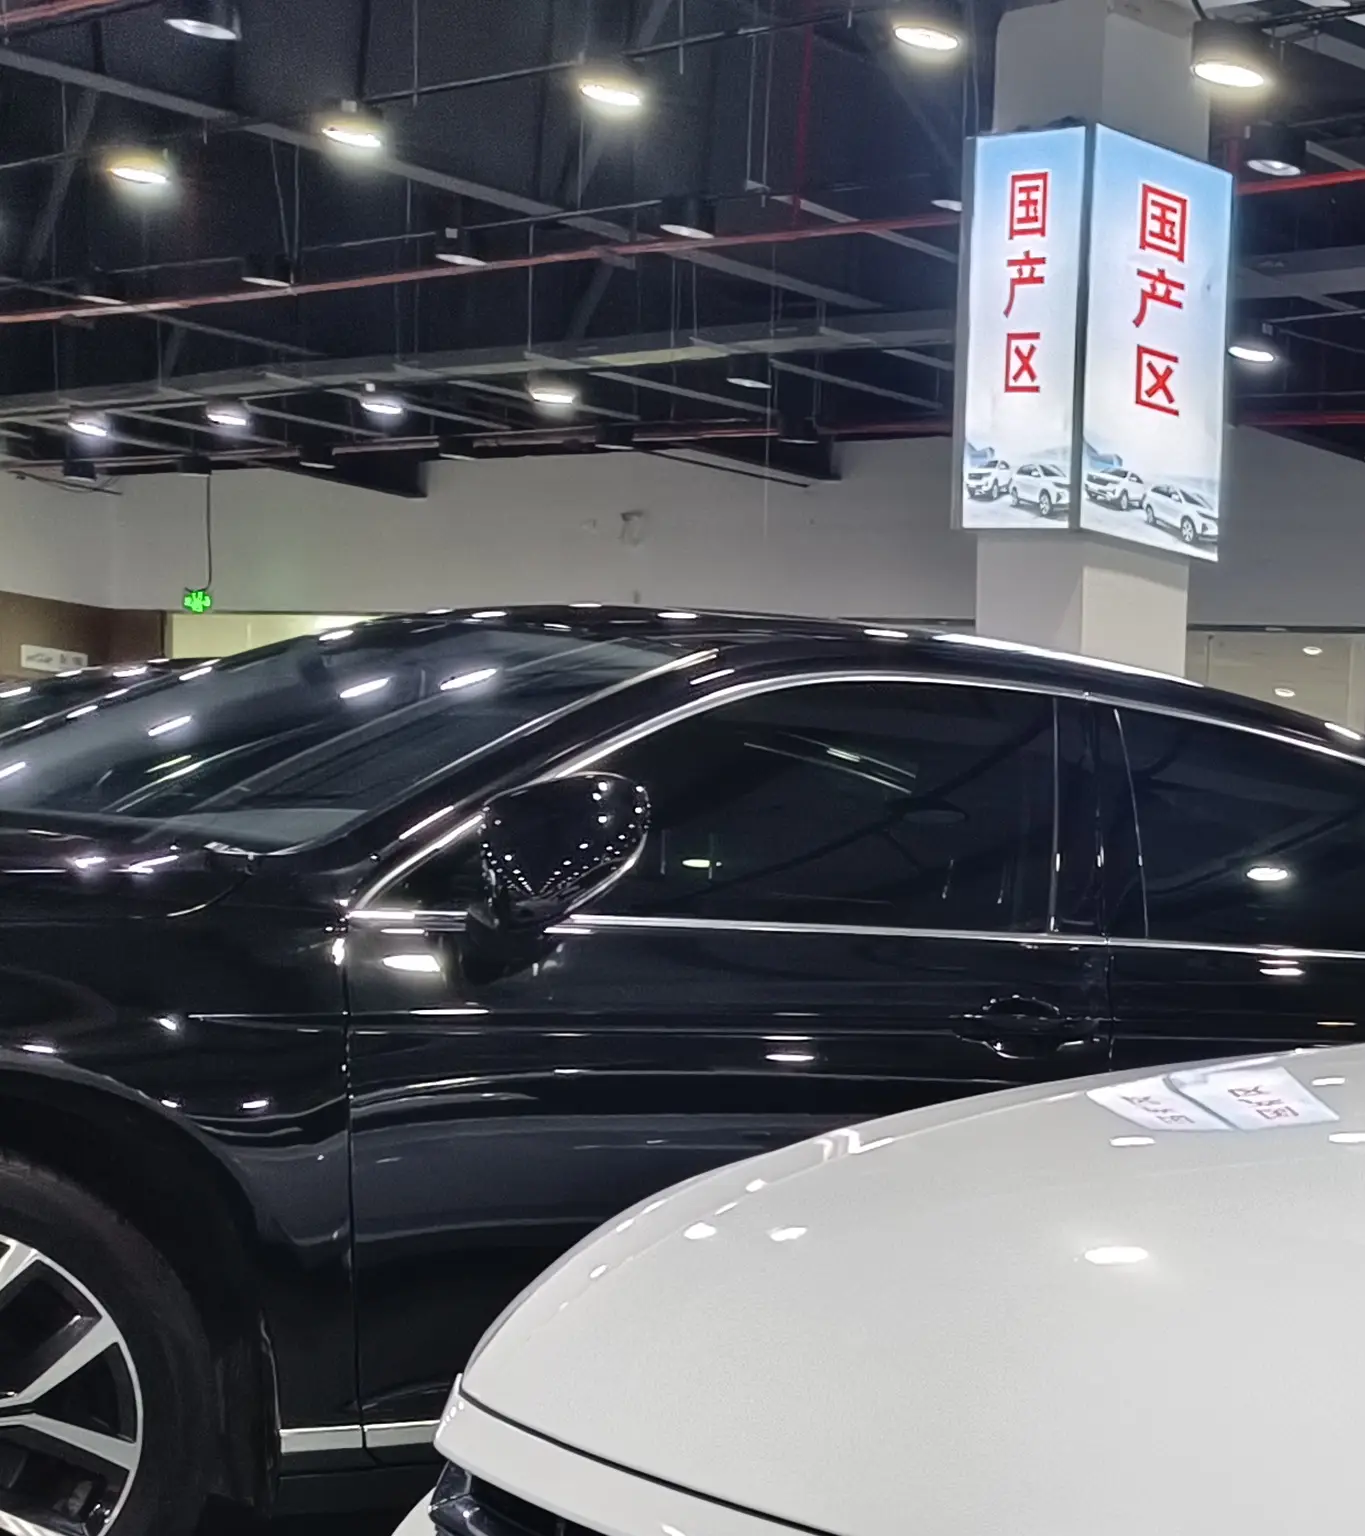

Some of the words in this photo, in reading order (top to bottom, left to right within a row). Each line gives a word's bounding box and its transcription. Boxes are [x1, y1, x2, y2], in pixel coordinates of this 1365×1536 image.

[1003, 171, 1050, 394] 国产区
[1132, 182, 1189, 417] 国产区
